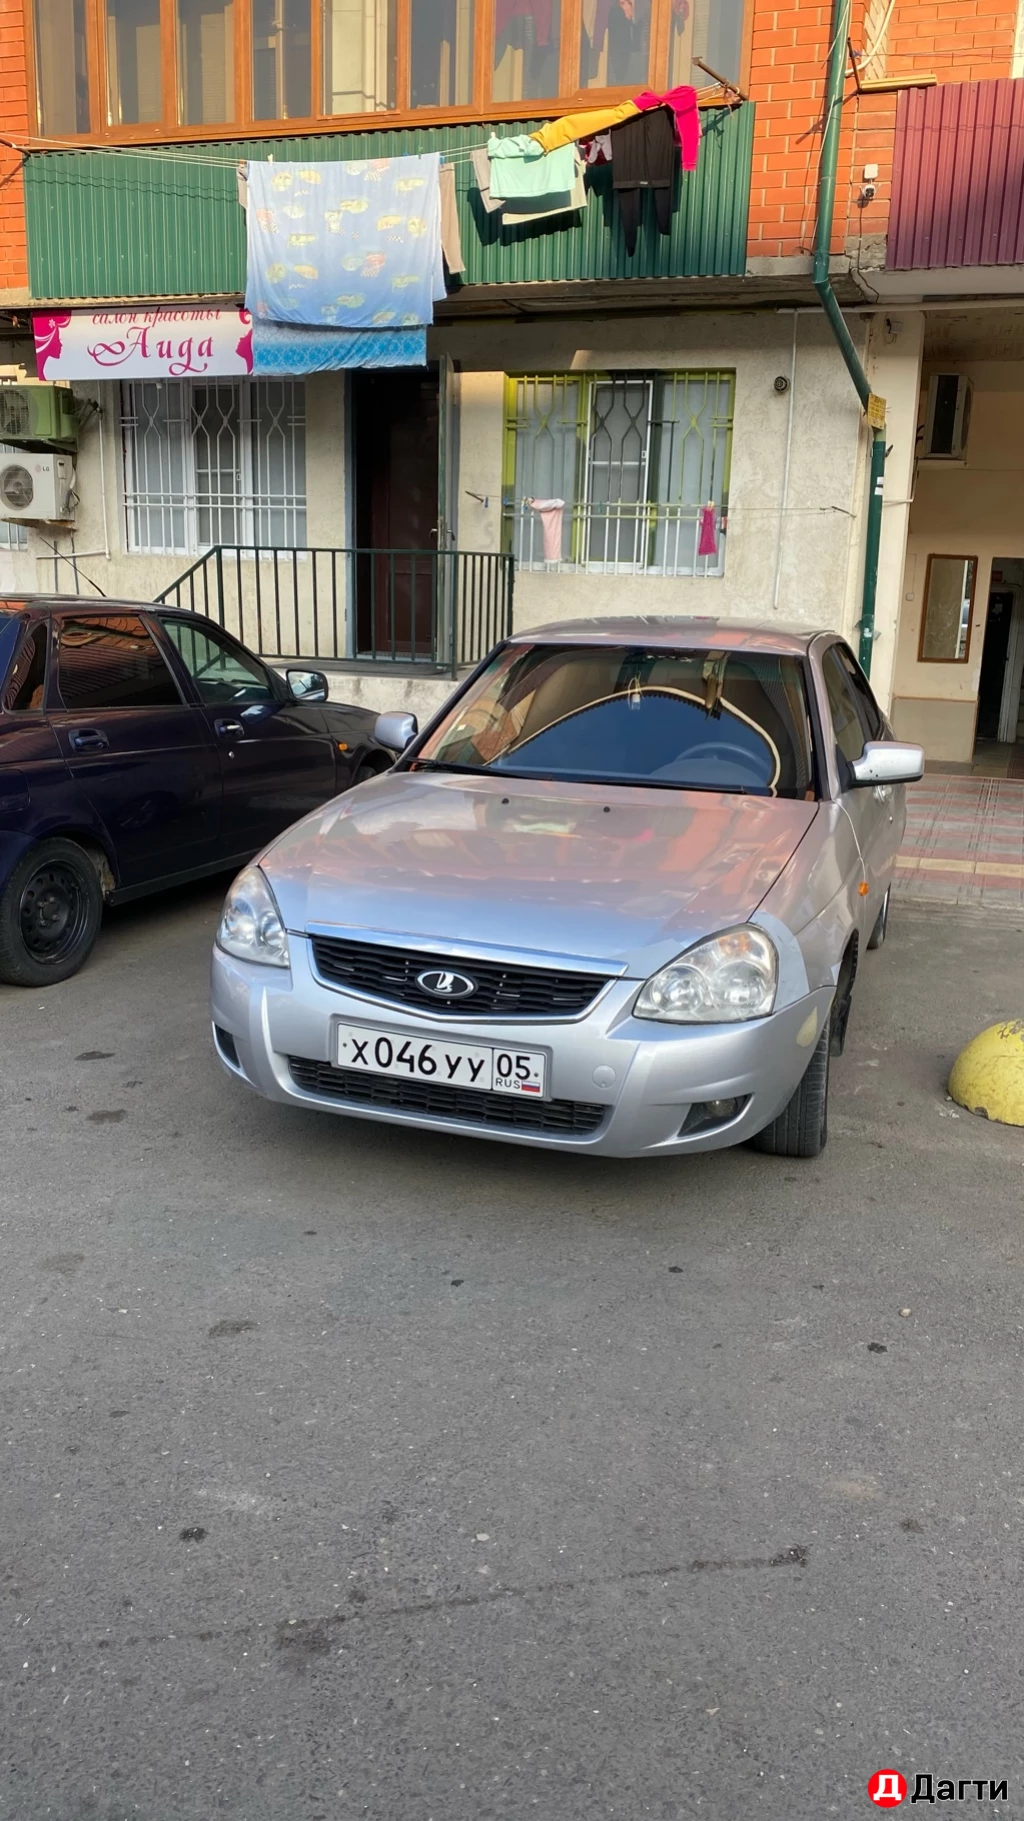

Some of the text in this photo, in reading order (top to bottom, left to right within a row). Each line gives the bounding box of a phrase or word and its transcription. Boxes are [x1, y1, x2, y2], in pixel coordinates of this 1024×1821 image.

[92, 306, 221, 328] салон красоты
[87, 325, 215, 376] Аида
[496, 1053, 531, 1080] 05
[495, 1077, 521, 1090] RUS
